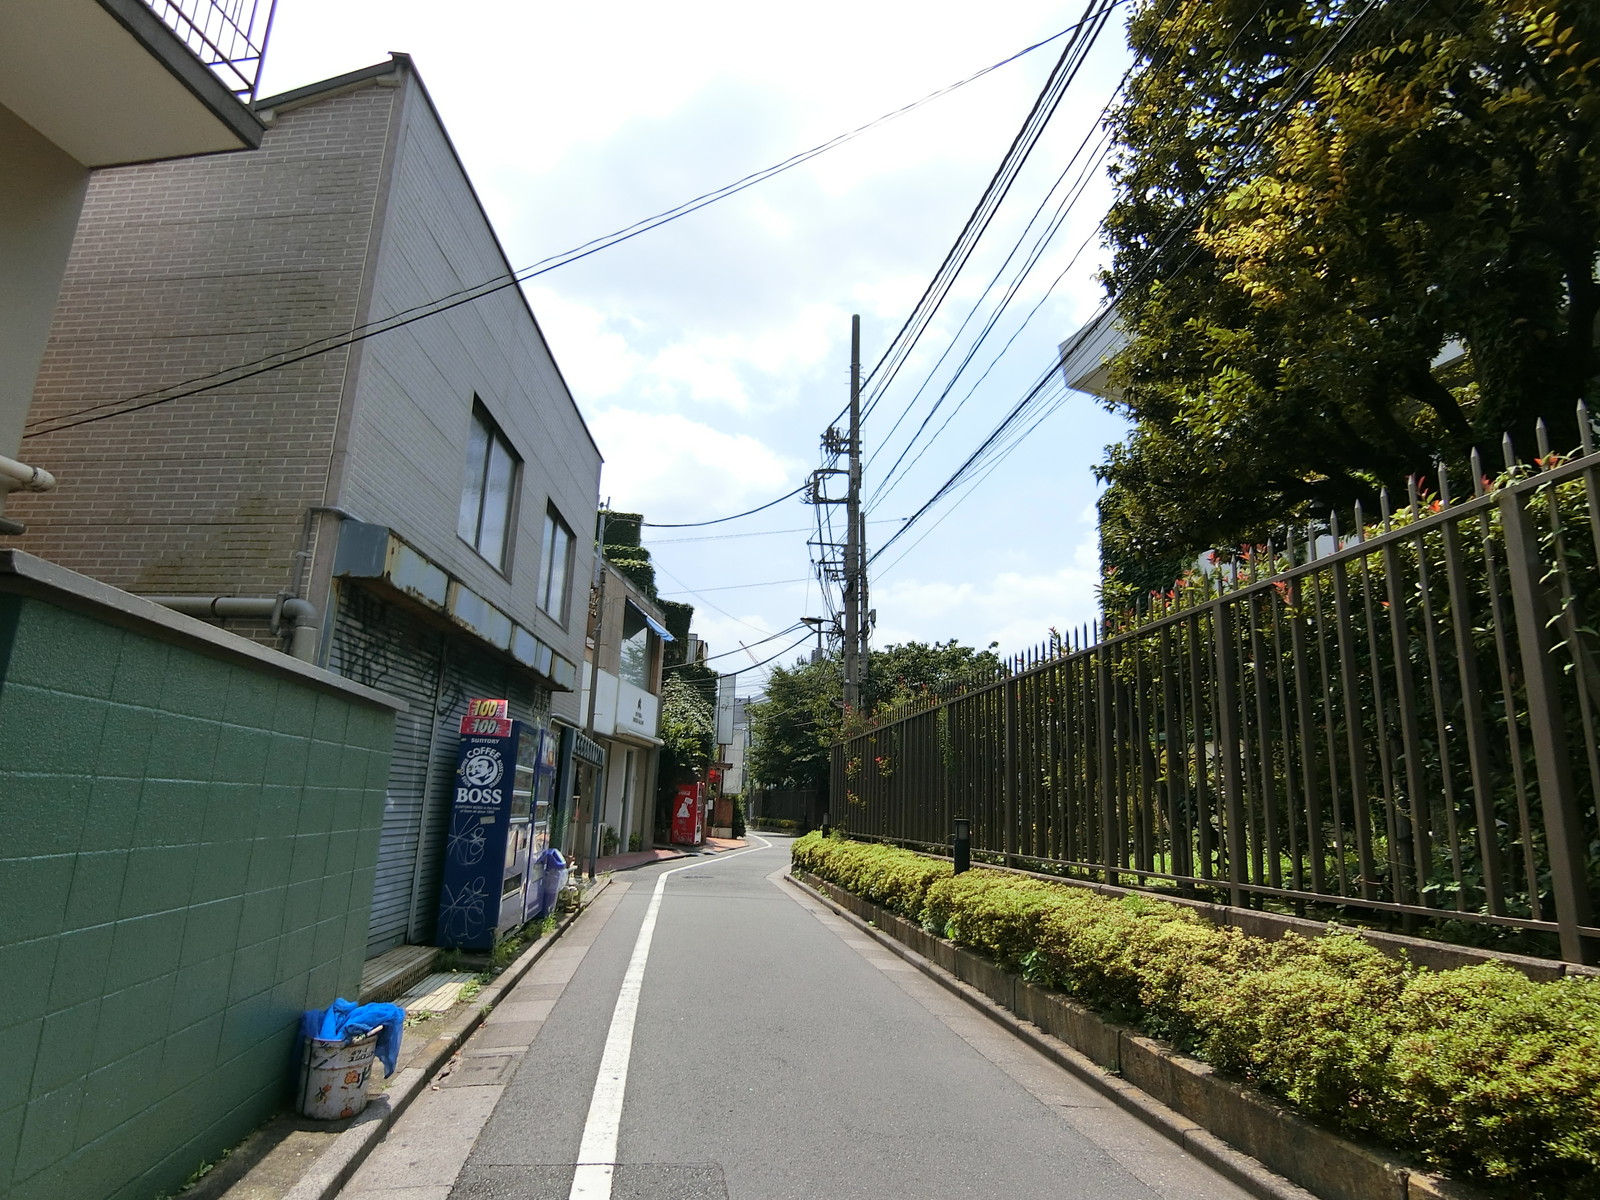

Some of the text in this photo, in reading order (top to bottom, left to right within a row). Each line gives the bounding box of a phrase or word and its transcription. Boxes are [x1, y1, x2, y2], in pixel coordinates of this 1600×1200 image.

[474, 700, 498, 717] 100
[473, 718, 497, 734] 100
[467, 746, 502, 760] COFFEE
[456, 787, 502, 804] BOSS
